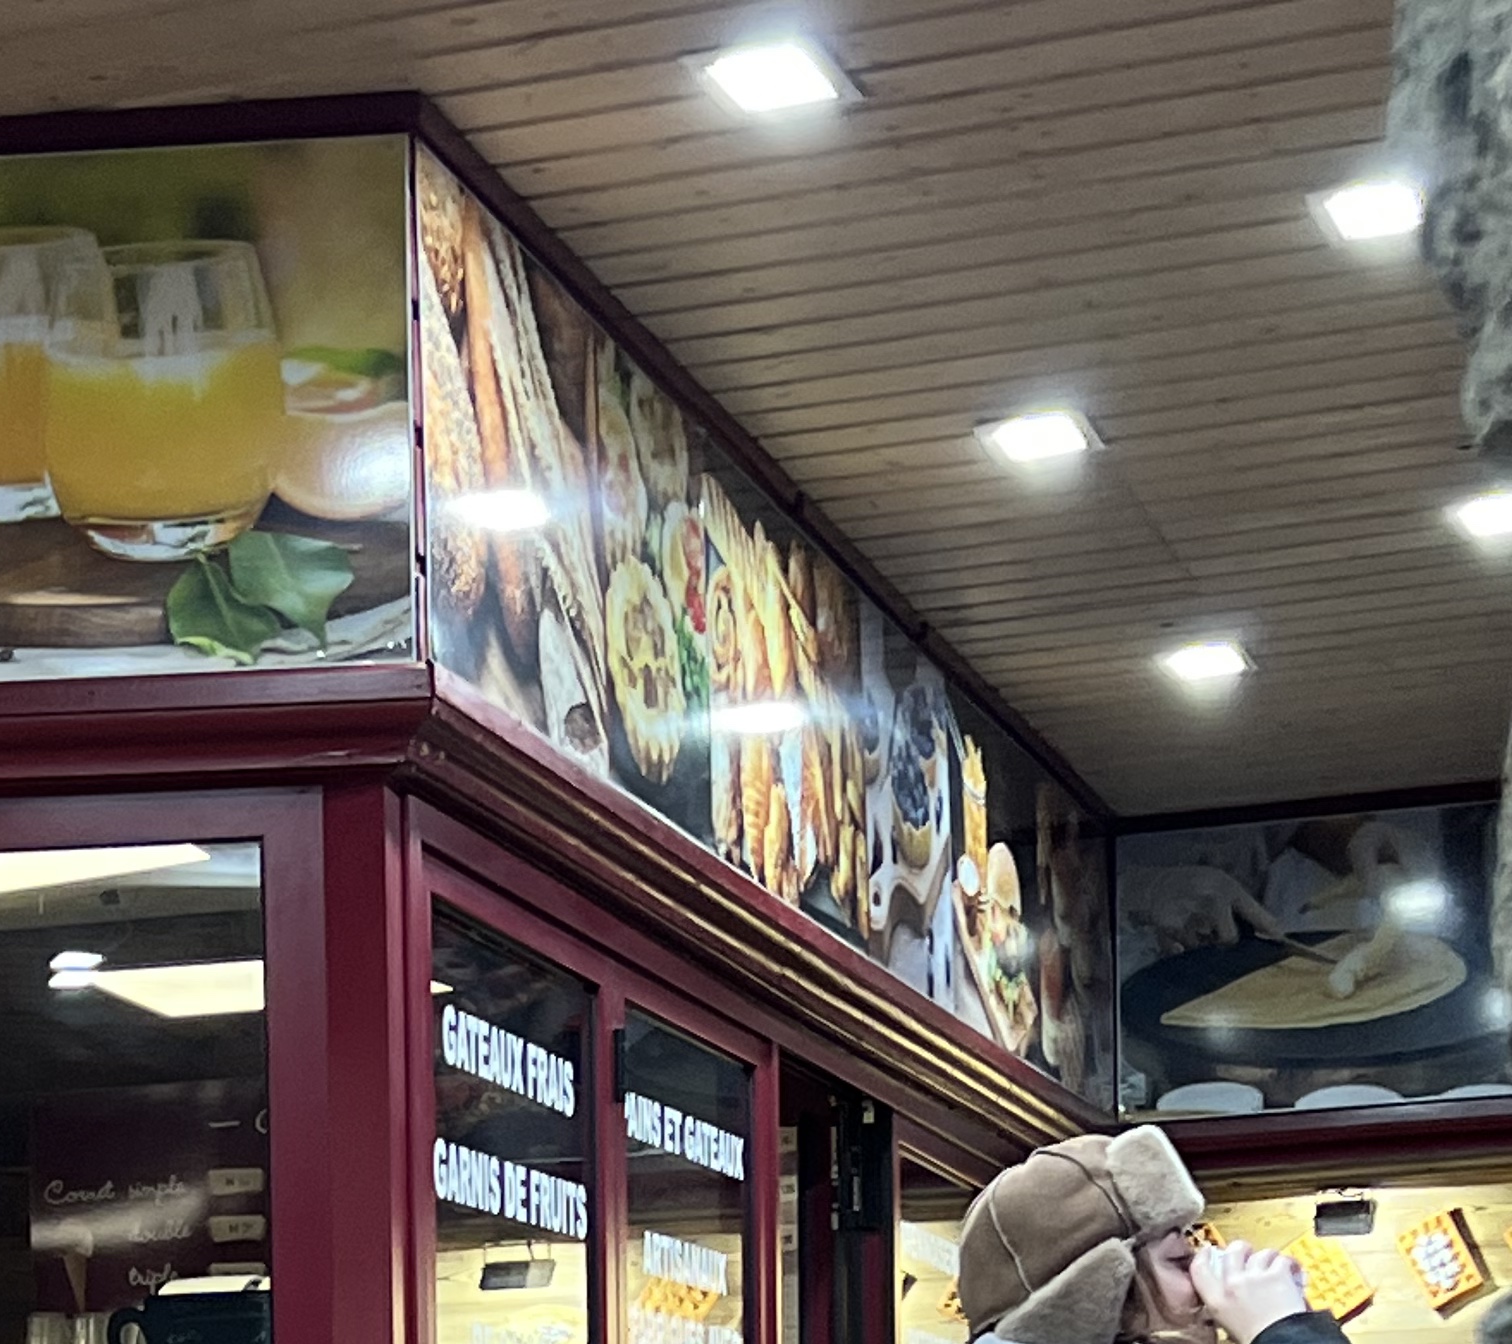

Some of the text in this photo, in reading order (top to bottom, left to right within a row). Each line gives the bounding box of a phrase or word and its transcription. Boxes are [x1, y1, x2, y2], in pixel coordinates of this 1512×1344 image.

[441, 1004, 576, 1118] GATEAUX FRAIS
[433, 1137, 588, 1240] GARNIS DE FRUITS
[664, 1105, 683, 1155] ET
[684, 1115, 744, 1181] GATEAUX
